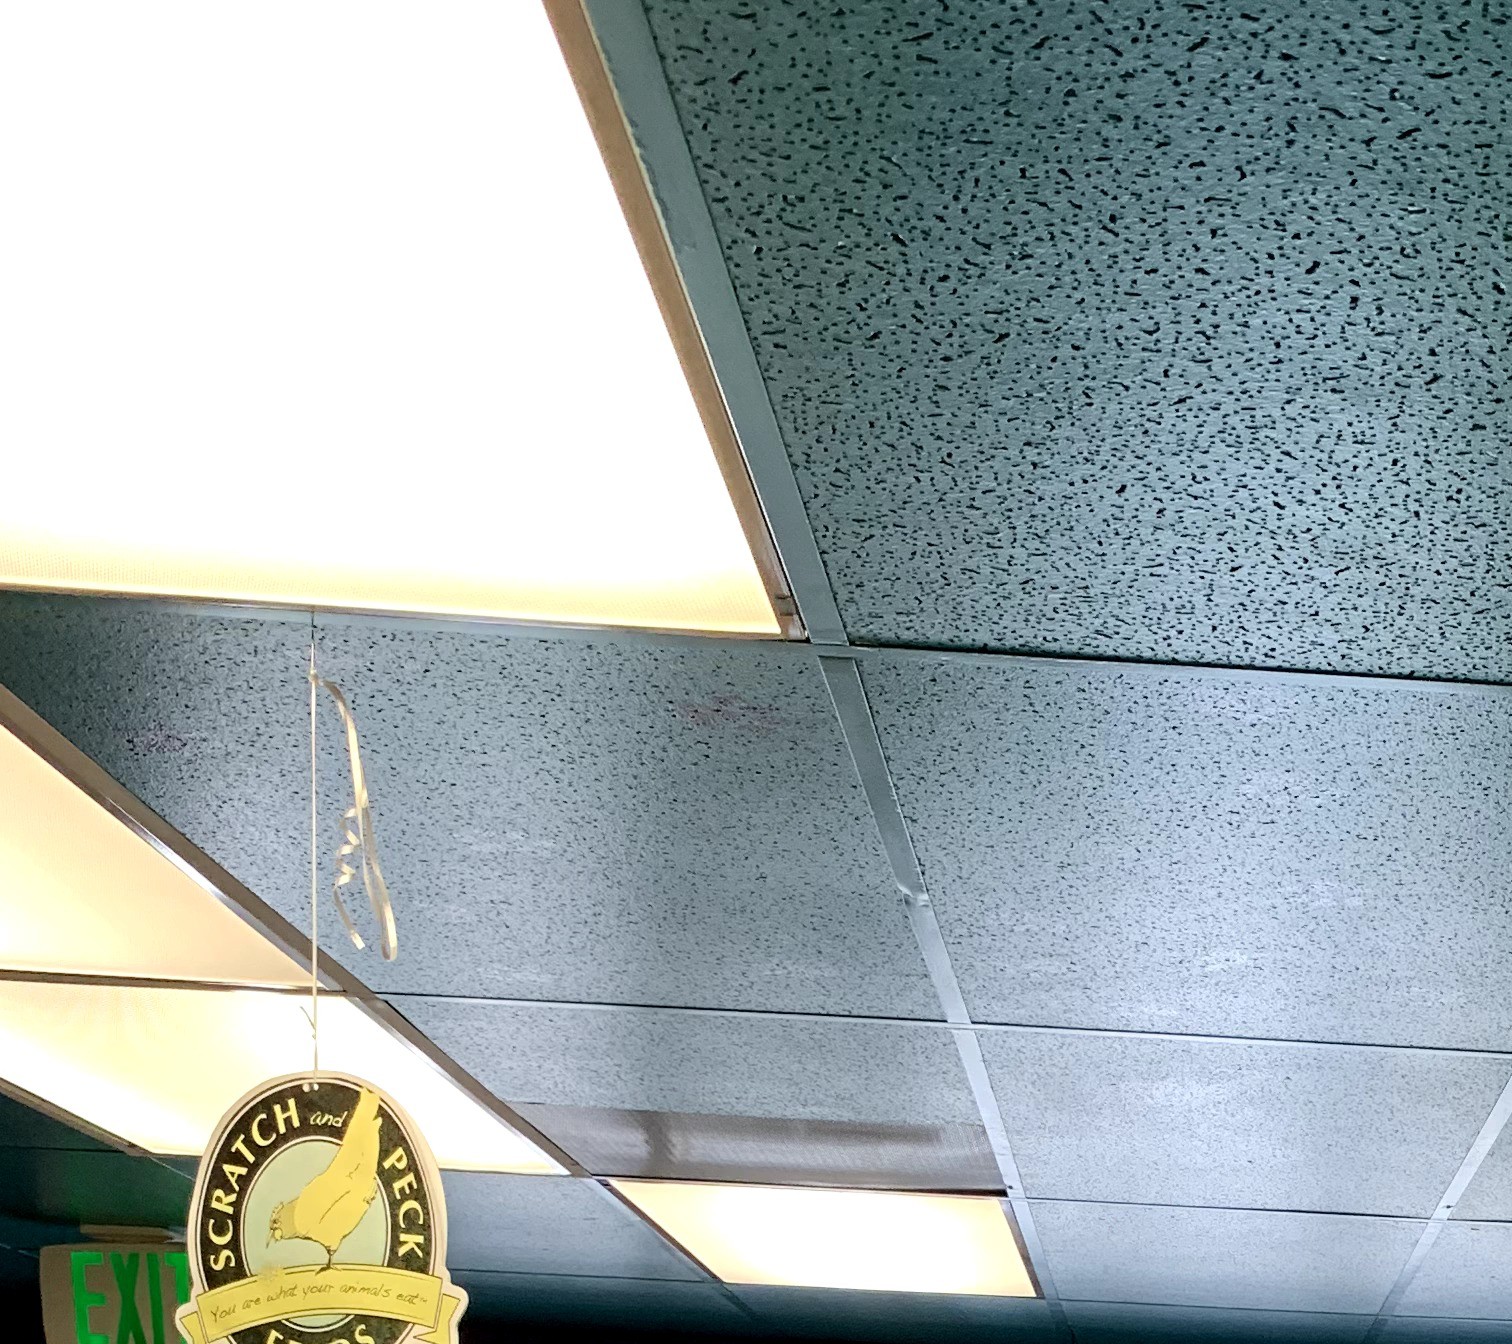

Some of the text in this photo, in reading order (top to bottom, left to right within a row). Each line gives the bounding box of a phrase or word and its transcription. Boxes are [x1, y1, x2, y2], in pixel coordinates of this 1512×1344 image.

[208, 1098, 424, 1271] SCRATCH and PECK
[210, 1282, 391, 1323] You are what your animals
